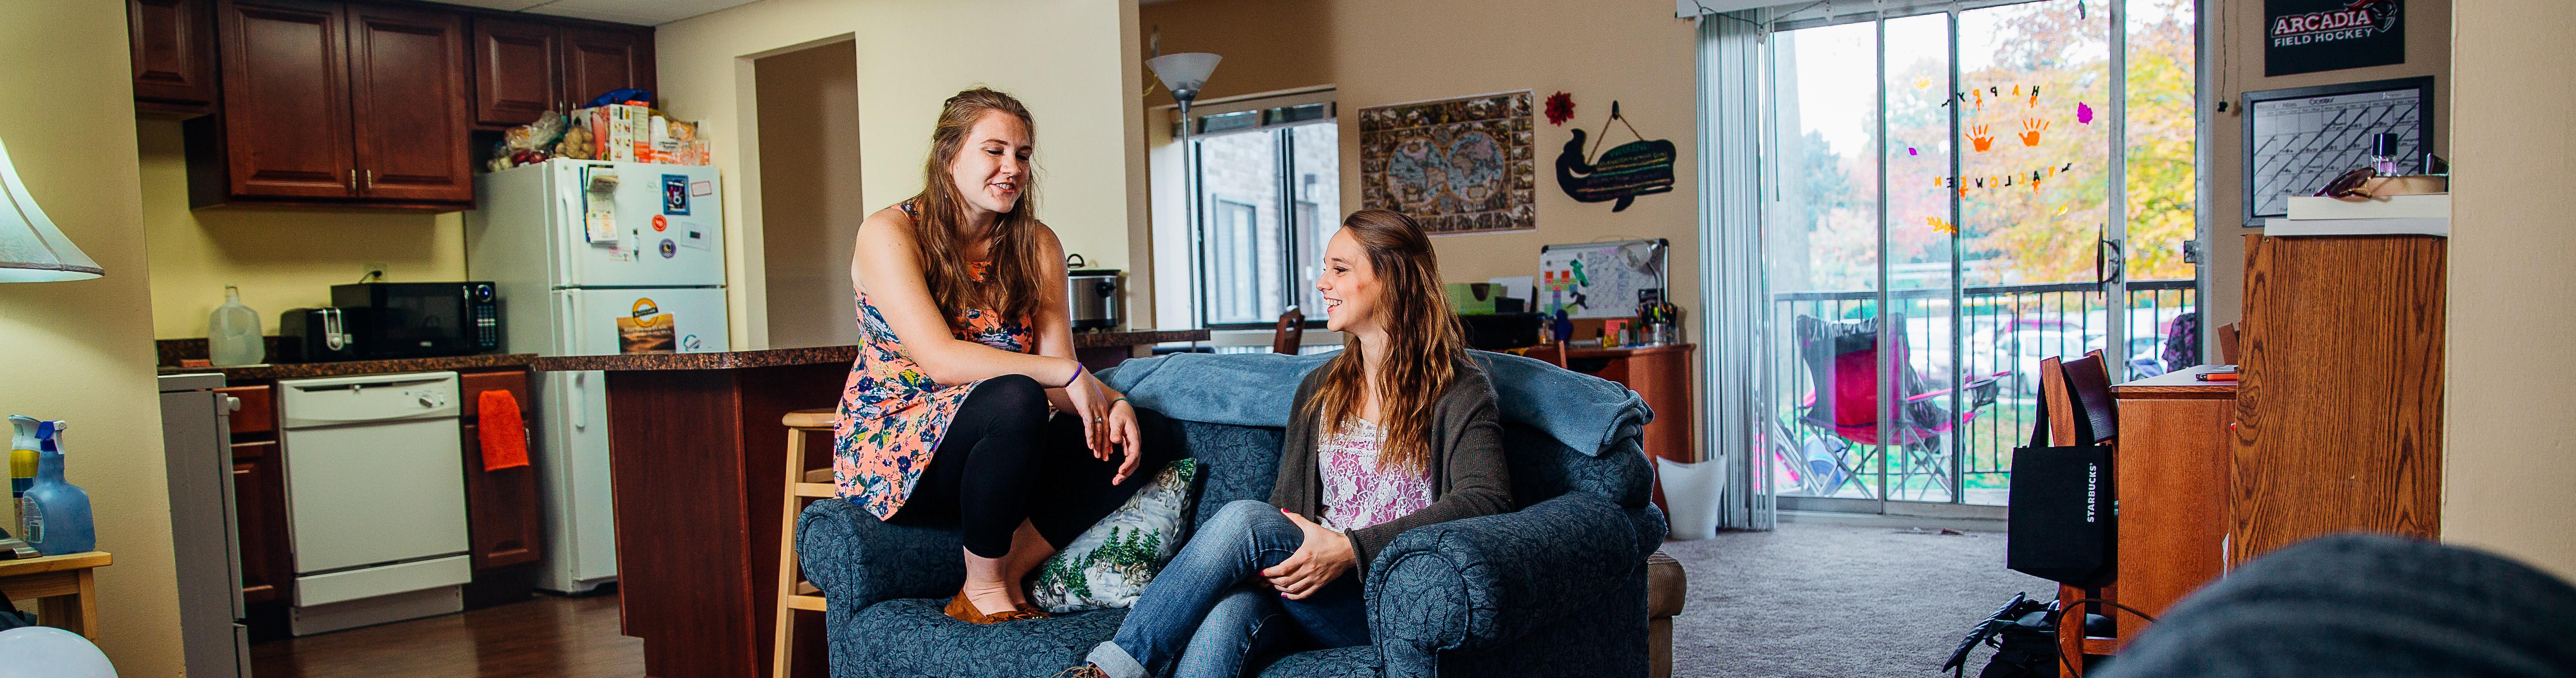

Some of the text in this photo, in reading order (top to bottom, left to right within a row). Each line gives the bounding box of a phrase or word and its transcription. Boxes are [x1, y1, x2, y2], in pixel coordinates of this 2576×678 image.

[2275, 9, 2371, 35] ARCADIA
[2275, 28, 2373, 47] FIELD HOCKEY
[2087, 465, 2097, 522] STARBUCKS
